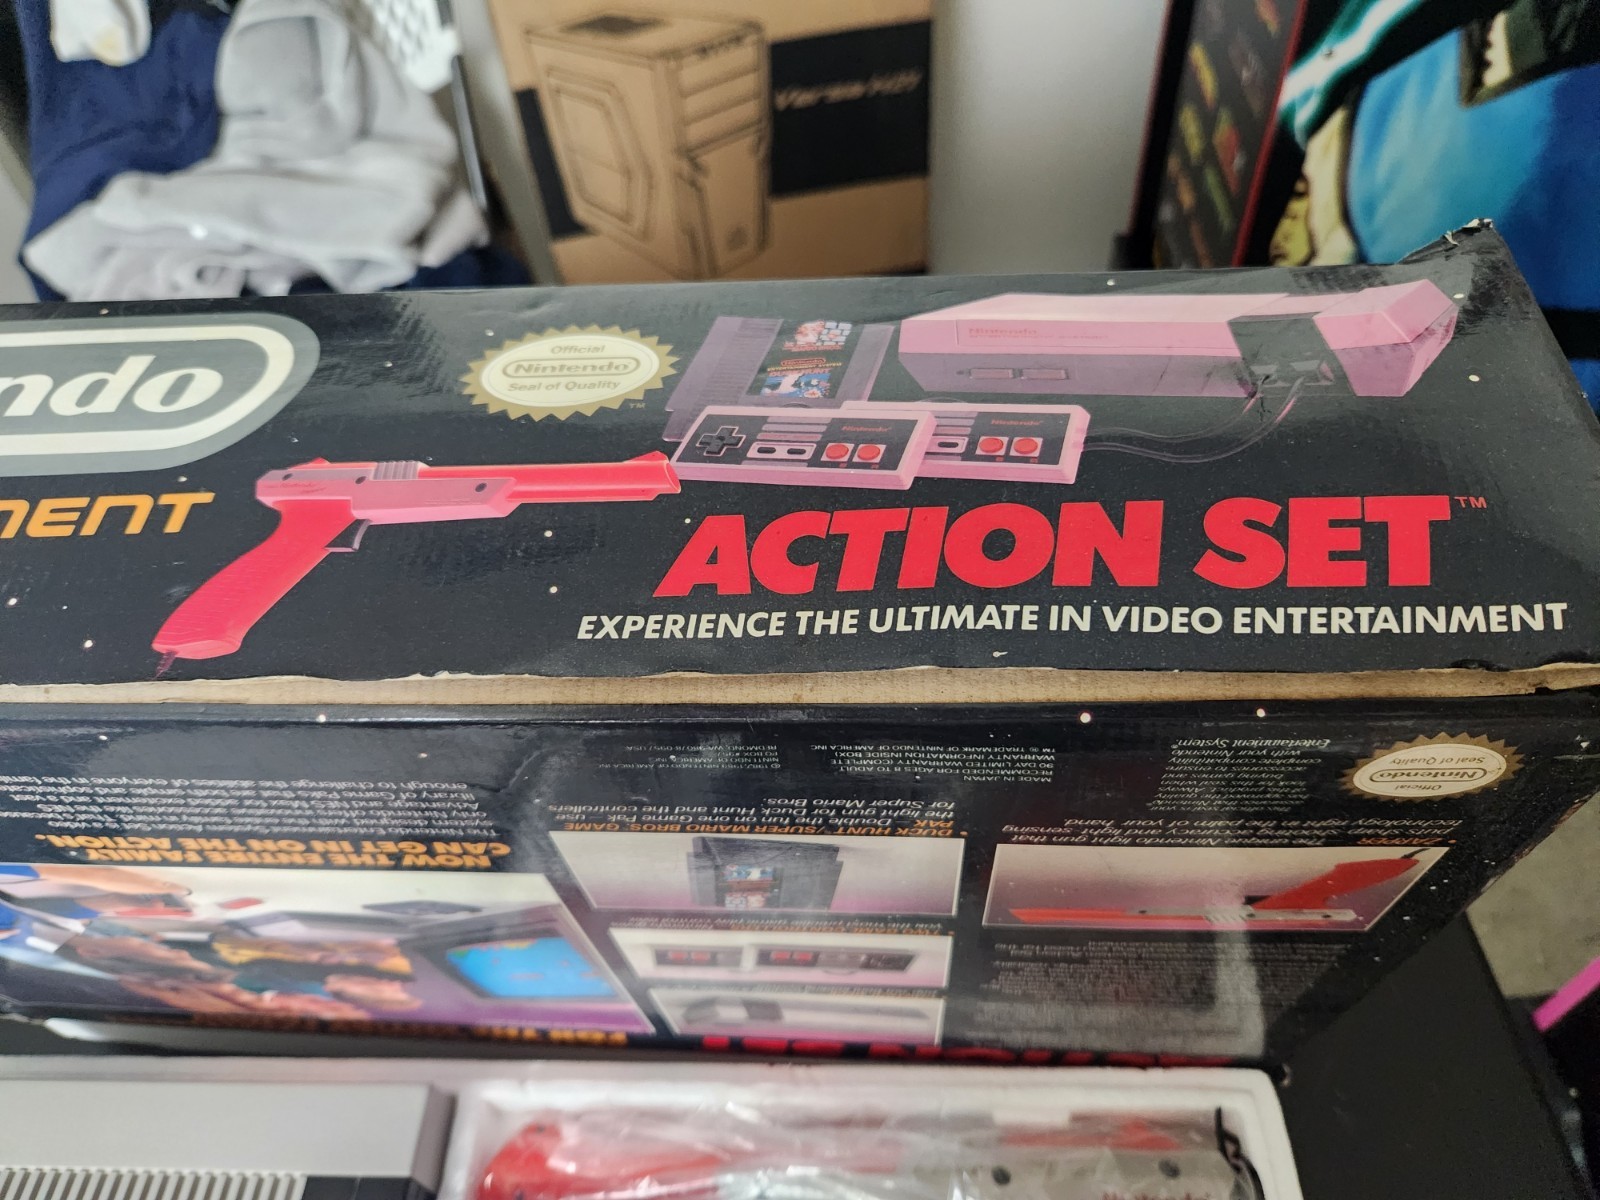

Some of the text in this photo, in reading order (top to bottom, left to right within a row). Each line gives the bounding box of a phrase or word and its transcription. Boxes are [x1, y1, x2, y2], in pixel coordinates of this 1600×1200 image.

[550, 344, 606, 355] Official
[514, 361, 631, 374] Nintendo
[508, 379, 621, 392] Seal of Quality
[653, 499, 1164, 597] ACTION
[1193, 495, 1451, 589] SET
[577, 602, 1569, 640] EXPERIENCE THE ULTIMATE IN VIDEO ENTERTAINMENT
[1233, 739, 1331, 748] Entertainment
[1389, 756, 1485, 766] Seal of Quality
[1378, 770, 1478, 779] Nintendo
[400, 792, 417, 800] of
[422, 792, 475, 800] library
[763, 798, 808, 806] Bros.
[812, 798, 865, 808] Mario
[869, 799, 924, 808] Super
[548, 805, 638, 813] controllers
[674, 806, 708, 814] and
[712, 806, 755, 814] Hunt
[761, 808, 806, 816] Duck
[810, 808, 836, 816] for
[841, 808, 876, 816] gun
[880, 808, 920, 818] light
[607, 814, 637, 822] Pak
[641, 814, 693, 822] Game
[924, 810, 954, 818] the
[762, 816, 790, 824] fun
[828, 817, 892, 825] Double
[1121, 818, 1164, 826] your
[1194, 818, 1244, 826] palm
[1302, 818, 1349, 827] right
[1351, 818, 1463, 827] technology
[564, 822, 620, 830] GAME
[686, 824, 750, 832] MARIO
[894, 827, 953, 835] DUCK
[1092, 835, 1132, 845] light
[1136, 837, 1222, 846] Nintendo
[1356, 837, 1442, 845] ZAPPER
[34, 834, 511, 856] CAN GET IN ON THE ACTION.
[84, 848, 491, 868] NOW THE ENTIRE FAMILY
